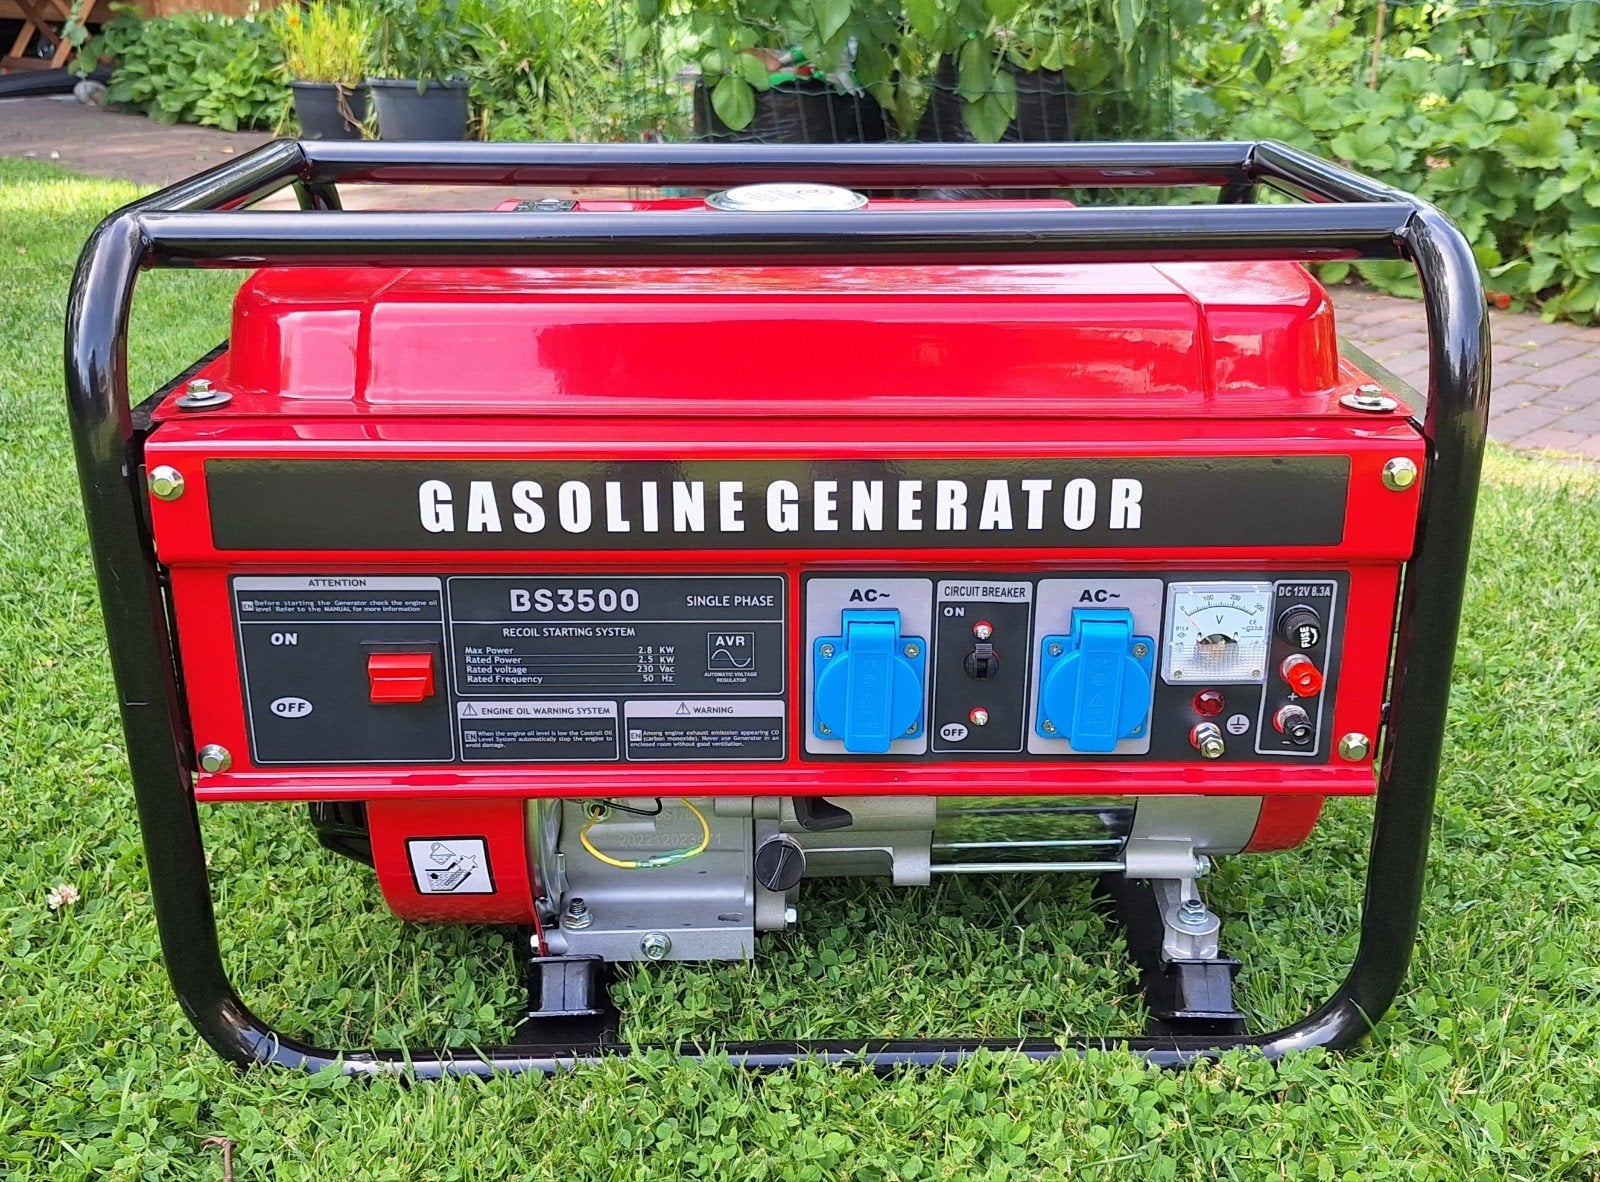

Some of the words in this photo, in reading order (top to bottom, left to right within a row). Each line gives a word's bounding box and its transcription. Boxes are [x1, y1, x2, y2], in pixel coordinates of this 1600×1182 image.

[418, 479, 746, 533] GASOLINE
[765, 478, 1144, 532] GENERATOR
[308, 579, 367, 587] ATTENTION
[944, 586, 980, 597] CIRCUIT
[982, 586, 1026, 598] BREAKER
[1278, 586, 1292, 597] DC
[1294, 586, 1311, 597] 12V
[1311, 586, 1331, 597] 8.3A
[509, 588, 640, 613] BS3500
[686, 595, 730, 607] SINGLE
[734, 595, 774, 607] PHASE
[1230, 593, 1242, 601] 200
[404, 600, 427, 608] engine
[943, 607, 965, 617] ON
[1216, 614, 1224, 624] V
[503, 628, 540, 637] RECOIL
[542, 628, 593, 637] STARTING
[595, 627, 636, 637] SYSTEM
[270, 632, 298, 645] ON
[715, 636, 746, 646] AVR
[1300, 626, 1311, 649] FUSE
[638, 646, 653, 654] 2.8
[659, 646, 675, 654] KW
[465, 656, 492, 664] Rated
[494, 656, 522, 664] Power
[638, 655, 653, 664] 2.5
[659, 656, 675, 664] KW
[466, 666, 493, 674] Rated
[495, 666, 528, 676] voltage
[637, 665, 654, 673] 230
[659, 665, 675, 673] Vac
[495, 676, 543, 685] Frequency
[643, 675, 654, 683] 50
[661, 675, 674, 683] Hz
[276, 702, 306, 713] OFF
[481, 707, 513, 715] ENGINE
[517, 707, 531, 715] OIL
[533, 707, 574, 715] WARNING
[577, 706, 610, 715] SYSTEM
[693, 706, 734, 714] WARNING
[943, 729, 964, 737] OFF
